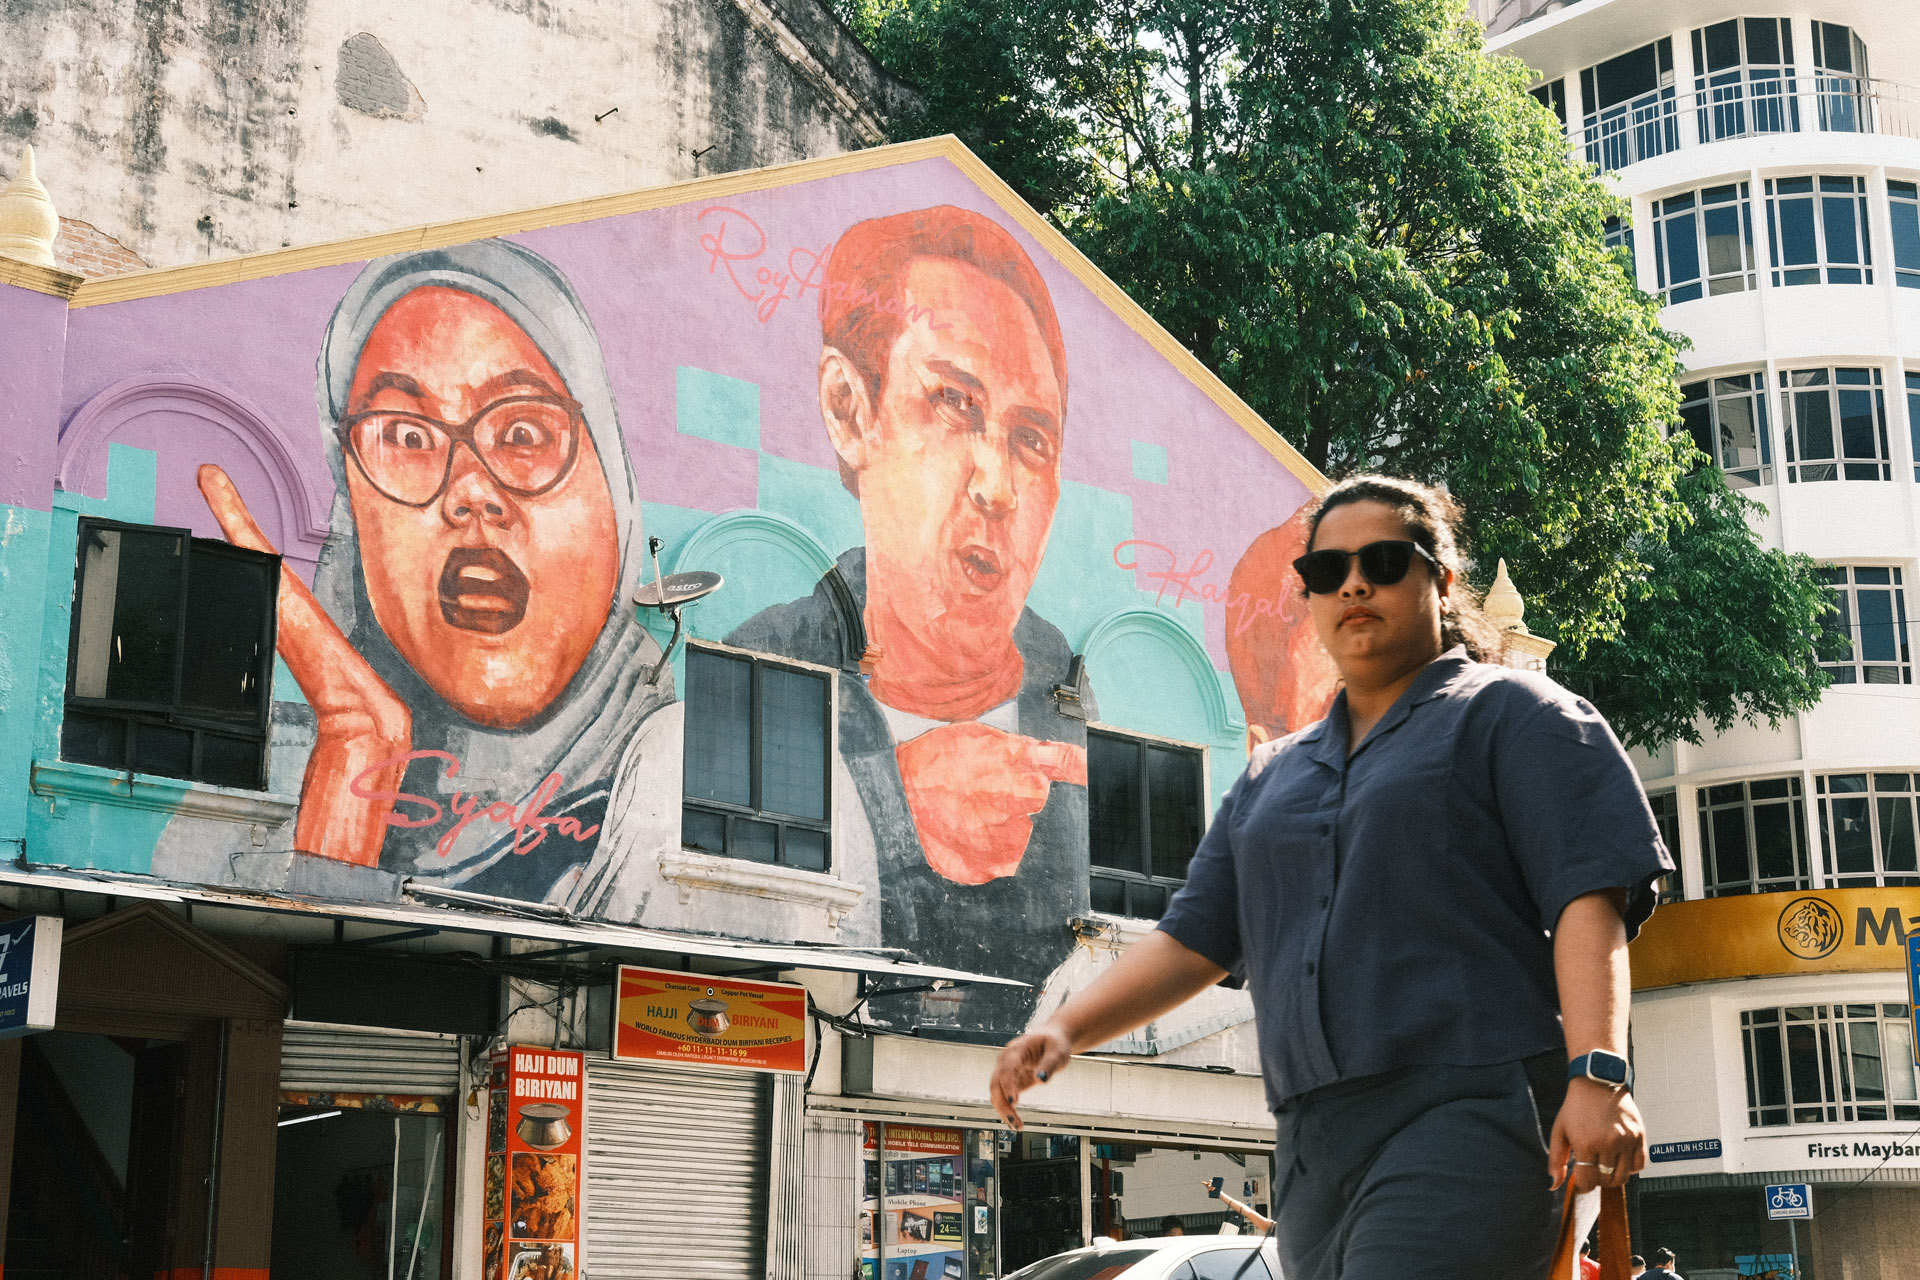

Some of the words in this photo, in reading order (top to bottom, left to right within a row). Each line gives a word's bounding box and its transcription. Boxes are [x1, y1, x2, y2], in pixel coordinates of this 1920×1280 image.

[697, 206, 790, 323] Roy
[666, 582, 703, 592] astro
[1855, 907, 1920, 946] M
[664, 983, 687, 991] Charcoal
[721, 989, 739, 997] Copper
[748, 991, 764, 999] Vessel
[647, 1005, 678, 1019] HAJJI
[698, 1016, 720, 1027] DUM
[732, 1014, 779, 1029] BIRIYANI
[635, 1021, 658, 1034] WORLD
[658, 1028, 686, 1041] FAMOUS
[686, 1035, 722, 1046] HYDERBADI
[738, 1039, 765, 1047] BIRIYANI
[765, 1035, 793, 1045] RECEPIES
[677, 1044, 691, 1052] +60
[515, 1053, 545, 1074] HAJI
[547, 1056, 578, 1076] DUM
[515, 1077, 577, 1100] BIRIYANI
[888, 1128, 932, 1141] INTERNATIONAL
[1652, 1145, 1675, 1155] JALAN
[1676, 1143, 1691, 1152] TUN
[1704, 1141, 1719, 1150] LEE
[1808, 1142, 1849, 1158] First
[888, 1199, 908, 1207] Mobile
[909, 1199, 927, 1207] Phone
[940, 1223, 950, 1233] 24
[897, 1247, 917, 1255] Laptop
